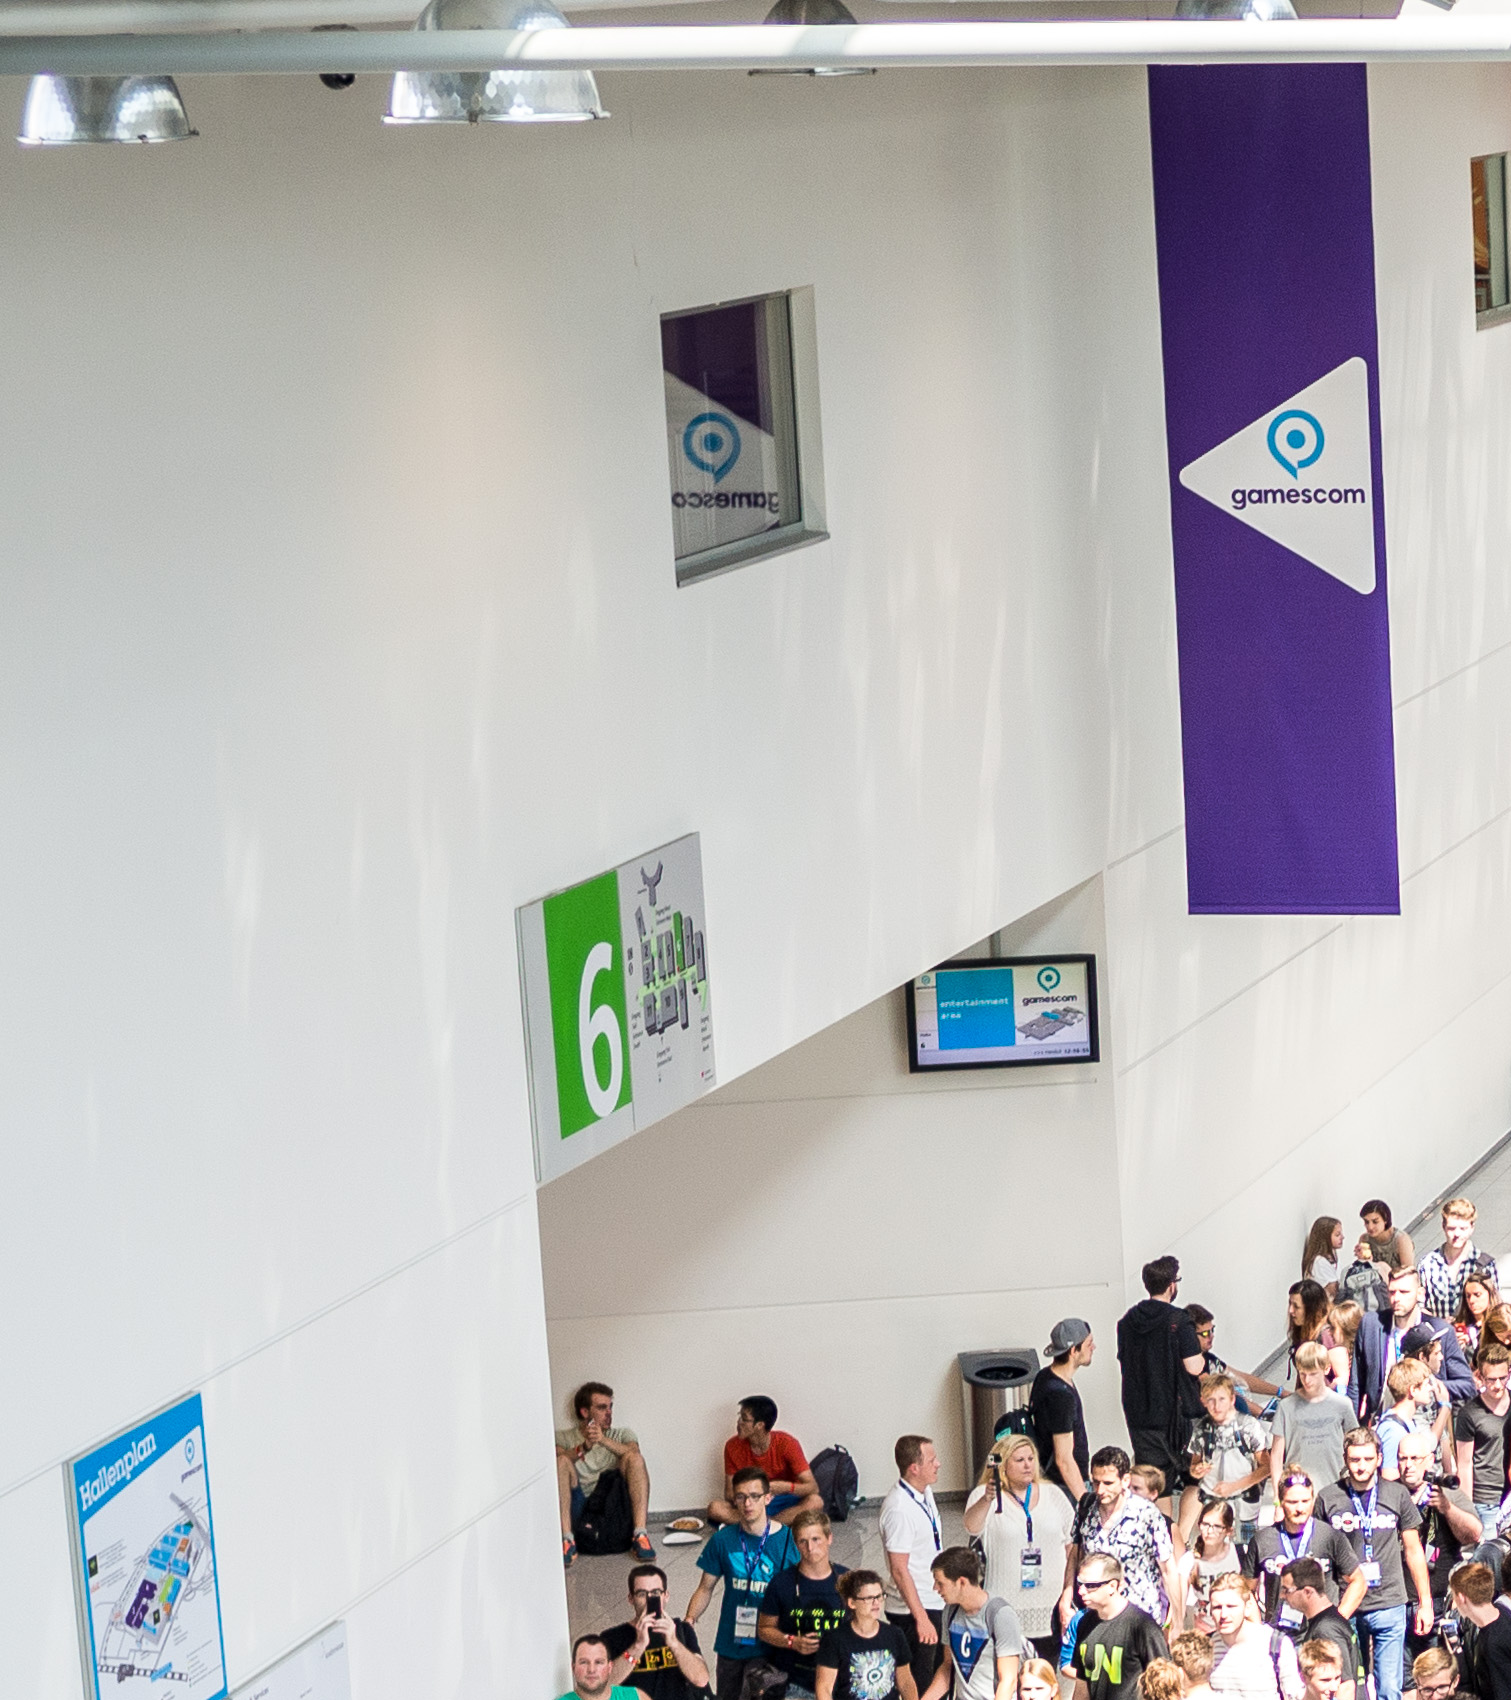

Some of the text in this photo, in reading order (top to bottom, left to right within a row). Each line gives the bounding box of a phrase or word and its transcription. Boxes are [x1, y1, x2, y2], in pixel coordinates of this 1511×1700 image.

[1231, 487, 1366, 511] gamescom
[938, 996, 1009, 1009] entertainment
[1022, 994, 1078, 1007] gamescom
[578, 941, 623, 1118] 6
[78, 1431, 158, 1512] Hallenplan
